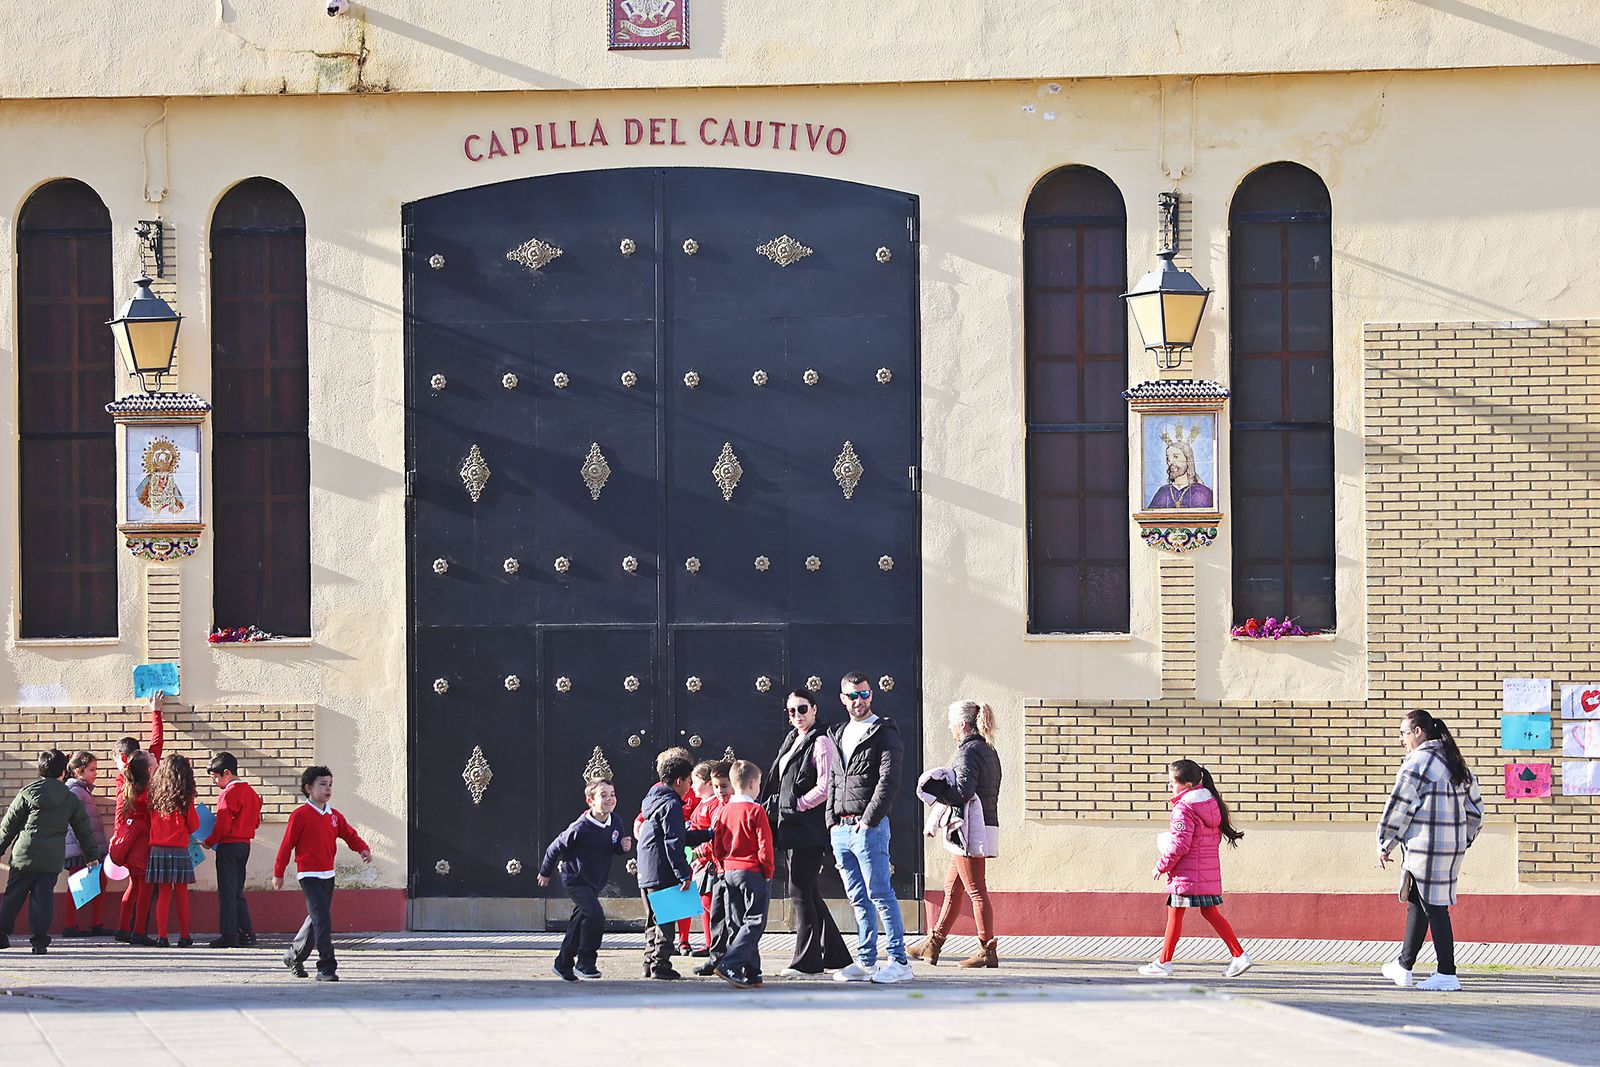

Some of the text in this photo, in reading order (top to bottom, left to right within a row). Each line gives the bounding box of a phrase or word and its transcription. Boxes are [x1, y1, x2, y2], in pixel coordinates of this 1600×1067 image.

[464, 117, 848, 162] CAPILLA DEL CAUTIVO
